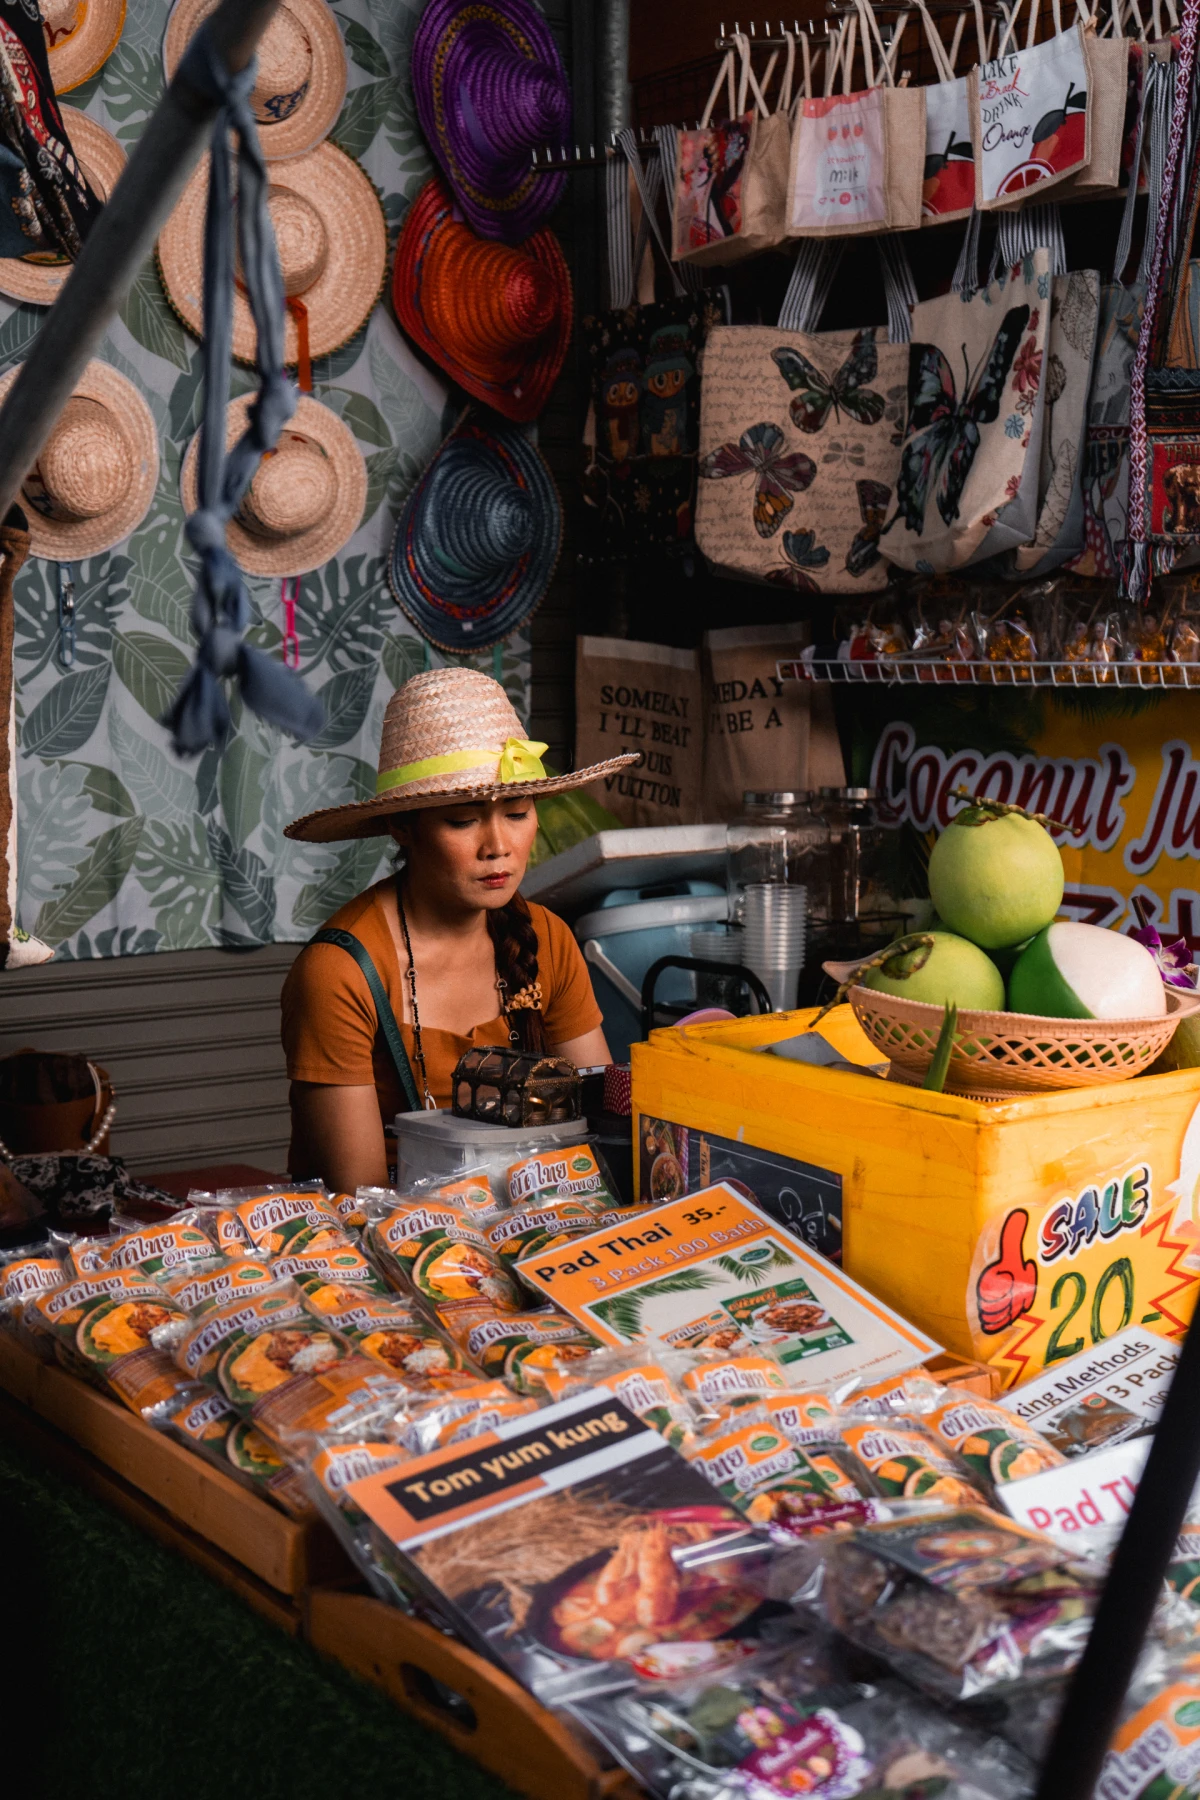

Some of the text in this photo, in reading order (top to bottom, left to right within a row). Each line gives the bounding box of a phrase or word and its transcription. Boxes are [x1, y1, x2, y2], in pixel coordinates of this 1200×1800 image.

[982, 93, 1023, 123] DRINK
[982, 122, 1032, 152] Orange
[652, 721, 691, 747] BEAT
[727, 710, 754, 734] BE
[765, 707, 782, 729] A
[872, 724, 1132, 848] Coconut
[250, 1197, 314, 1230] ผัดไทย
[388, 1209, 456, 1242] ผัดไทย
[1040, 1165, 1151, 1263] SALE
[535, 1250, 600, 1283] Pad
[598, 1222, 673, 1257] Thai
[588, 1275, 607, 1289] 3
[607, 1255, 665, 1282] Pack
[665, 1238, 709, 1260] 100
[709, 1217, 766, 1244] Bath
[1054, 1340, 1150, 1394] Methods
[1106, 1353, 1180, 1399] 3 Pack
[404, 1464, 482, 1503] Tom
[481, 1442, 550, 1480] yum
[546, 1410, 629, 1450] kung
